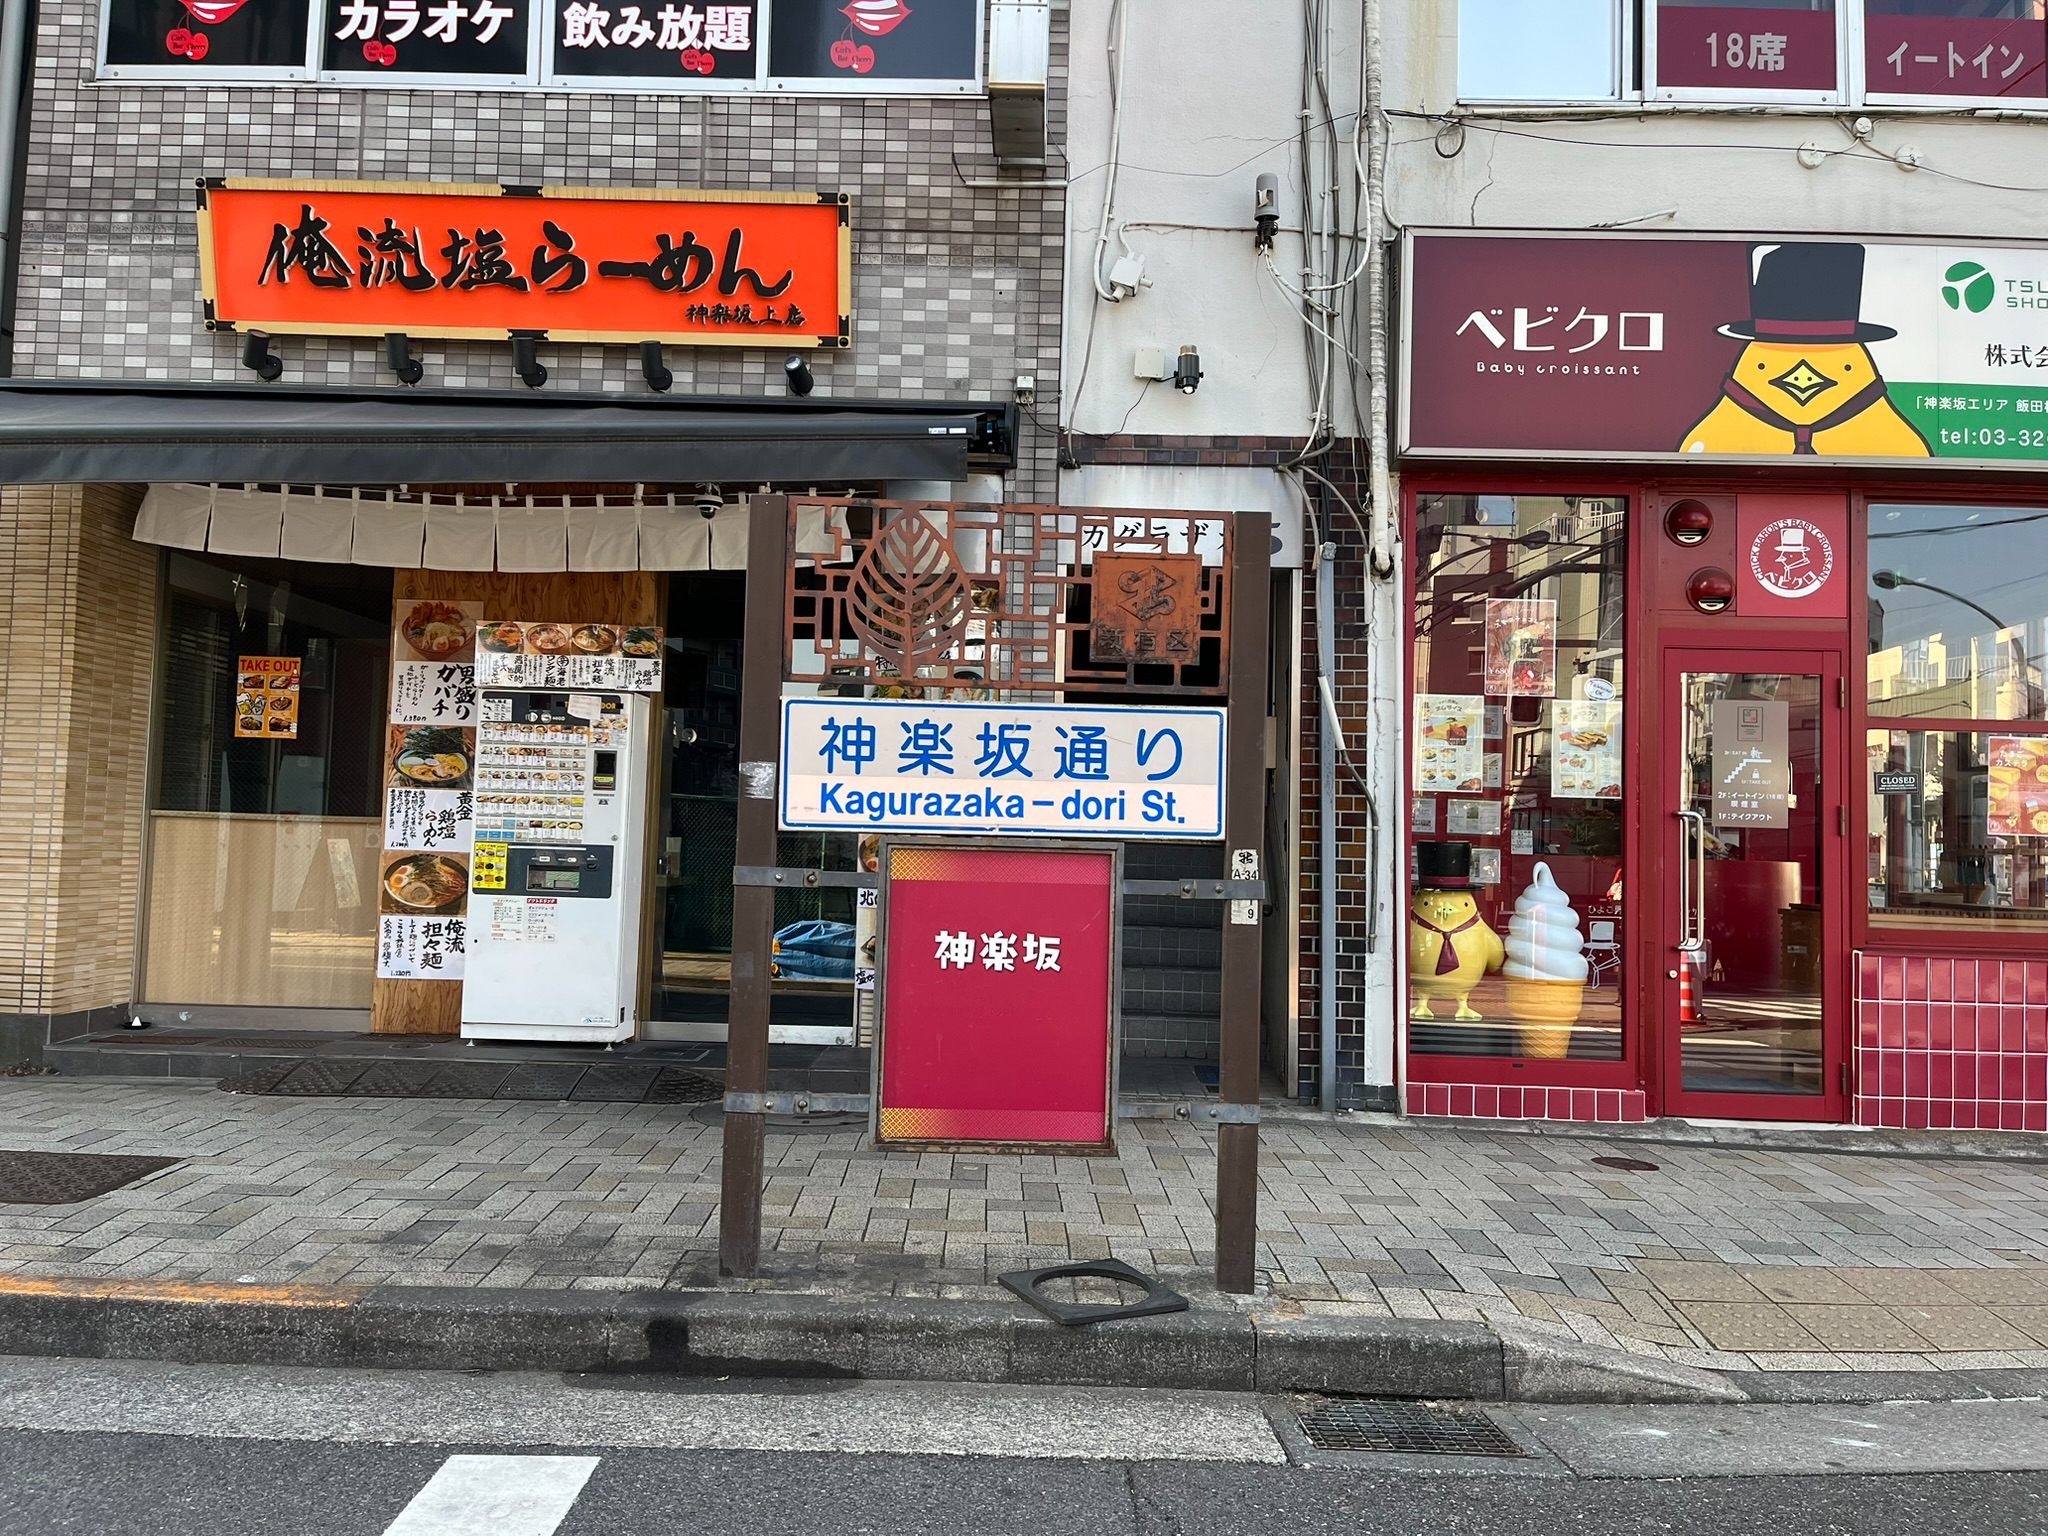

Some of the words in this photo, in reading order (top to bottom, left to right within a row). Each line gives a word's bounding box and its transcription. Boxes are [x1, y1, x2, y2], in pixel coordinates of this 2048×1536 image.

[334, 0, 514, 44] カラオケ
[562, 1, 752, 51] 飲み放題
[1705, 32, 1788, 72] 18席
[1886, 41, 2024, 79] イートイン
[258, 204, 795, 297] 俺流塩らーめん
[1455, 306, 1663, 354] ベビクロ
[1476, 361, 1526, 376] Baby
[1536, 362, 1640, 376] croissant
[1940, 427, 2048, 447] tel:03-32
[1081, 521, 1224, 551] カグラザ
[1751, 551, 1764, 581] CHICK
[1791, 519, 1817, 534] BABY
[1815, 531, 1832, 585] CROISSANT
[1764, 571, 1818, 590] ベビクロ
[240, 659, 271, 672] TAKE
[273, 660, 300, 672] OUT
[818, 716, 1183, 781] 神楽坂通り
[1880, 776, 1915, 785] CLOSED
[455, 791, 474, 821] 黄金
[1140, 789, 1185, 824] St.
[1233, 868, 1257, 880] A-34
[420, 921, 444, 970] 担々麺
[444, 918, 467, 954] 俺流
[934, 930, 1061, 971] 神楽坂
